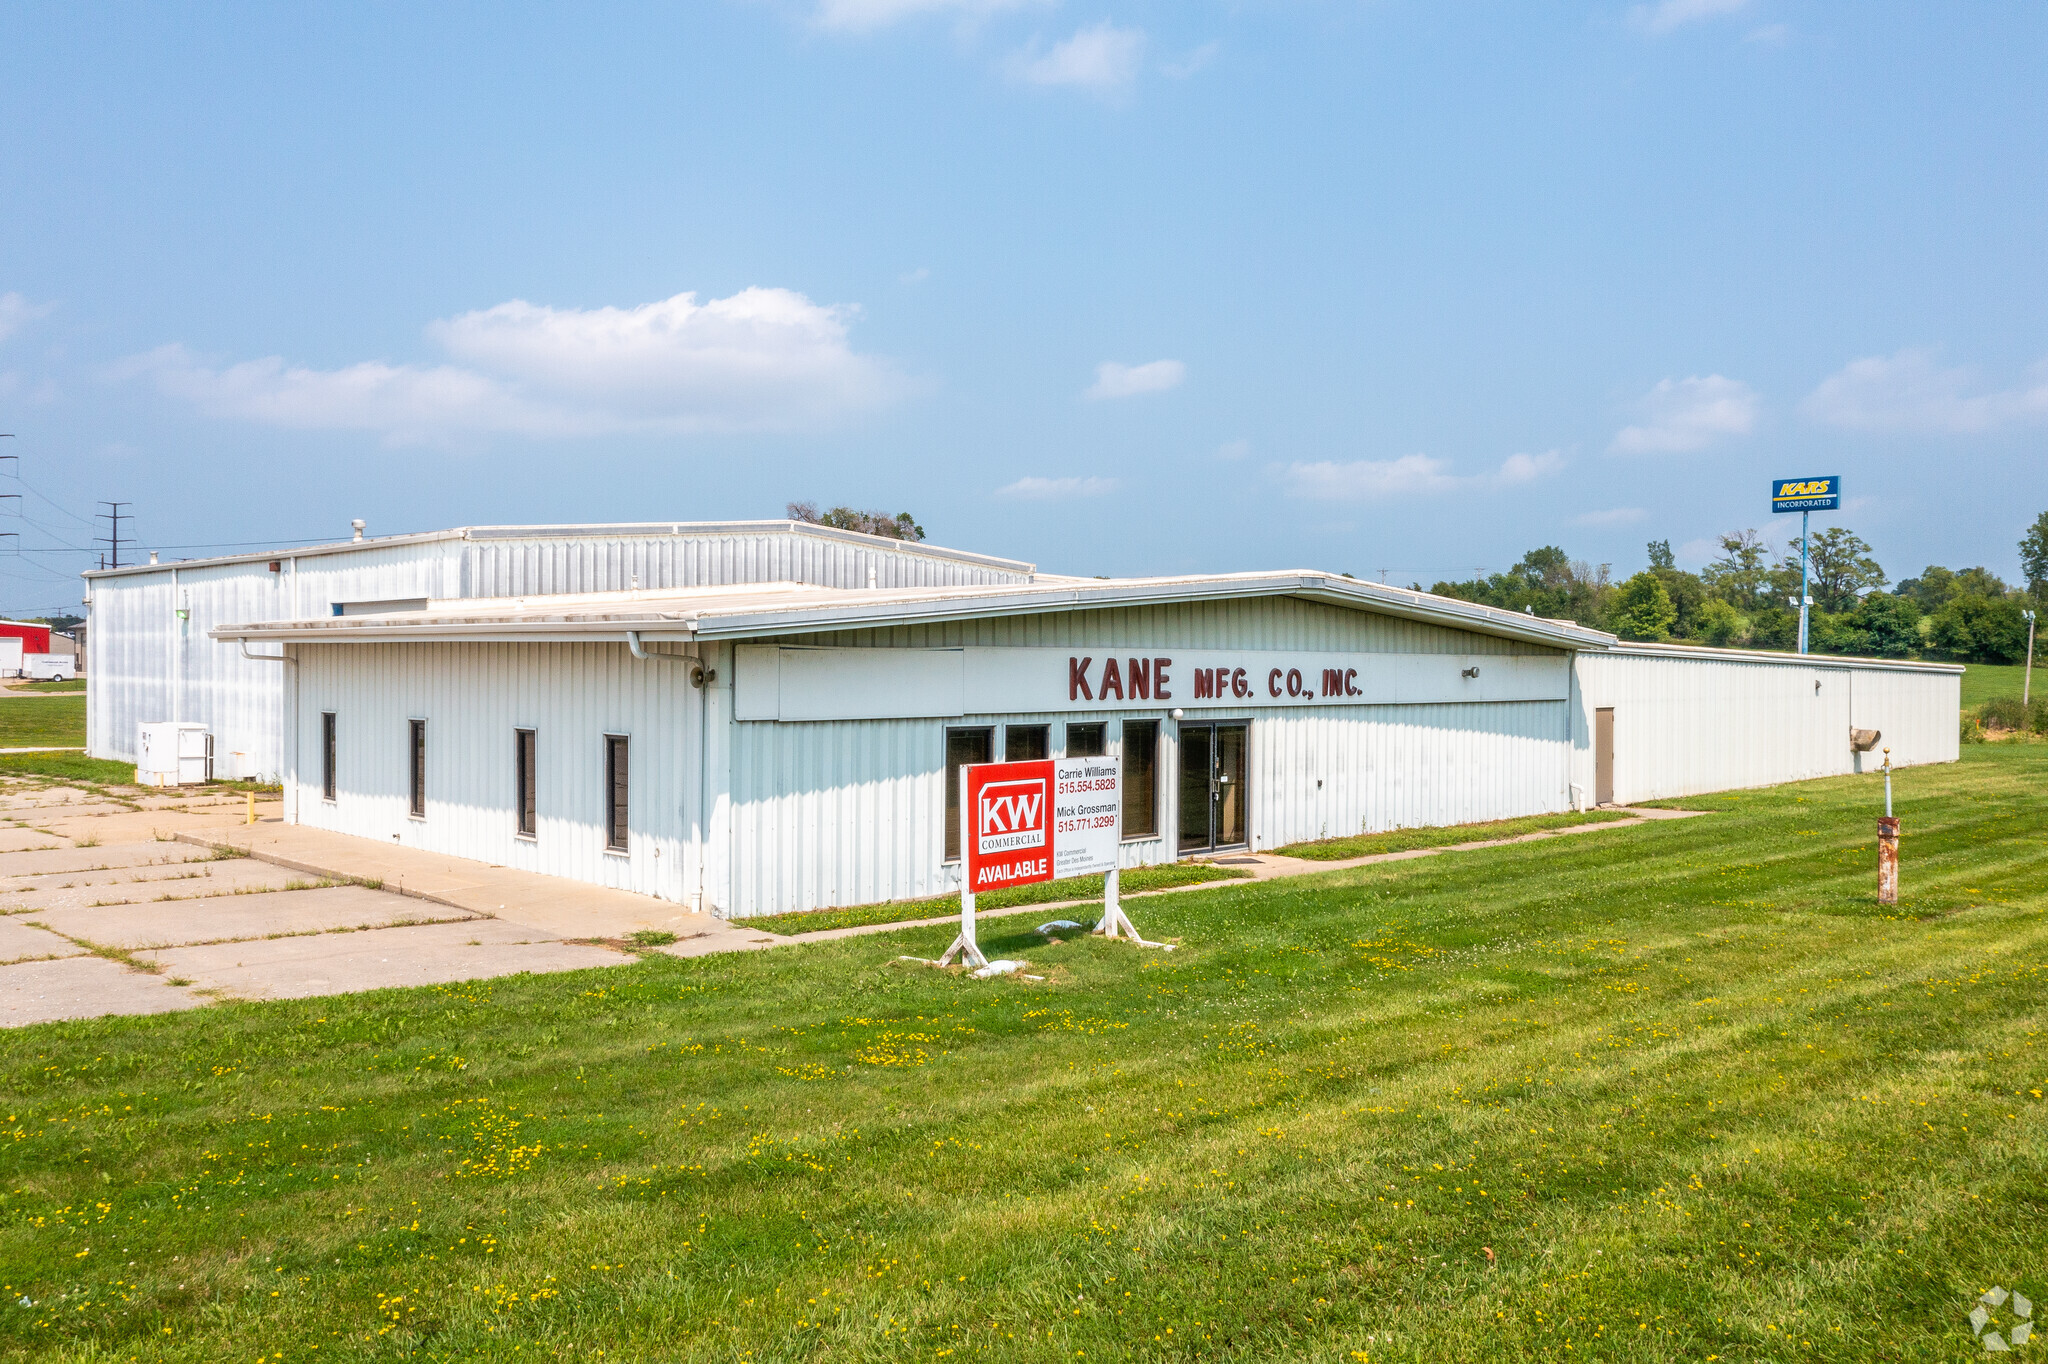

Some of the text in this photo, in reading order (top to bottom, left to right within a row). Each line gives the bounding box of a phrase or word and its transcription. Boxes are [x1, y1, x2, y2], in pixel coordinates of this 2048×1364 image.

[1779, 480, 1830, 496] KARS
[1777, 499, 1832, 508] INCORPORATED
[1069, 656, 1363, 700] KANE MFG. CO., INC.
[1058, 766, 1117, 780] Carrie Williams
[1058, 778, 1116, 794] 515.554.5828
[982, 793, 1042, 834] KW
[1056, 803, 1117, 818] Mick Grossman
[1058, 815, 1115, 833] 515.771.3299
[981, 833, 1042, 850] COMMERCIAL
[1064, 848, 1087, 857] Commercial
[1056, 859, 1071, 867] Greater
[977, 858, 1047, 885] AVAILABLE
